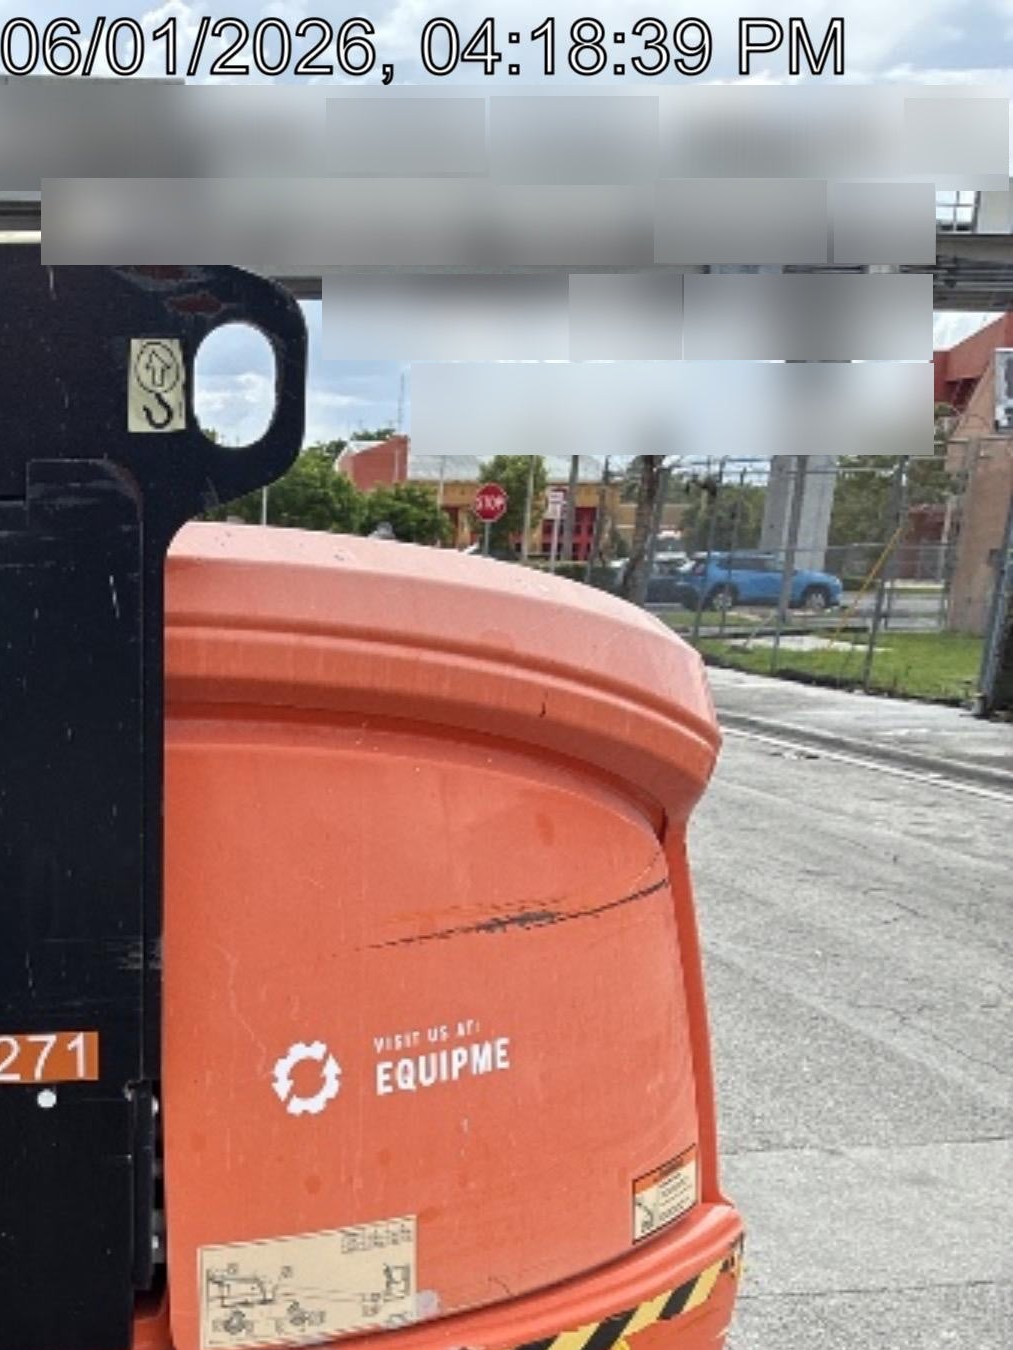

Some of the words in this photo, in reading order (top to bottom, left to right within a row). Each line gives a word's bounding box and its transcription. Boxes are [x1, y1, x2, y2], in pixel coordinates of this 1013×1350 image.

[374, 1031, 420, 1053] VISIT
[428, 1025, 448, 1042] US
[376, 1037, 510, 1096] EQUIPME
